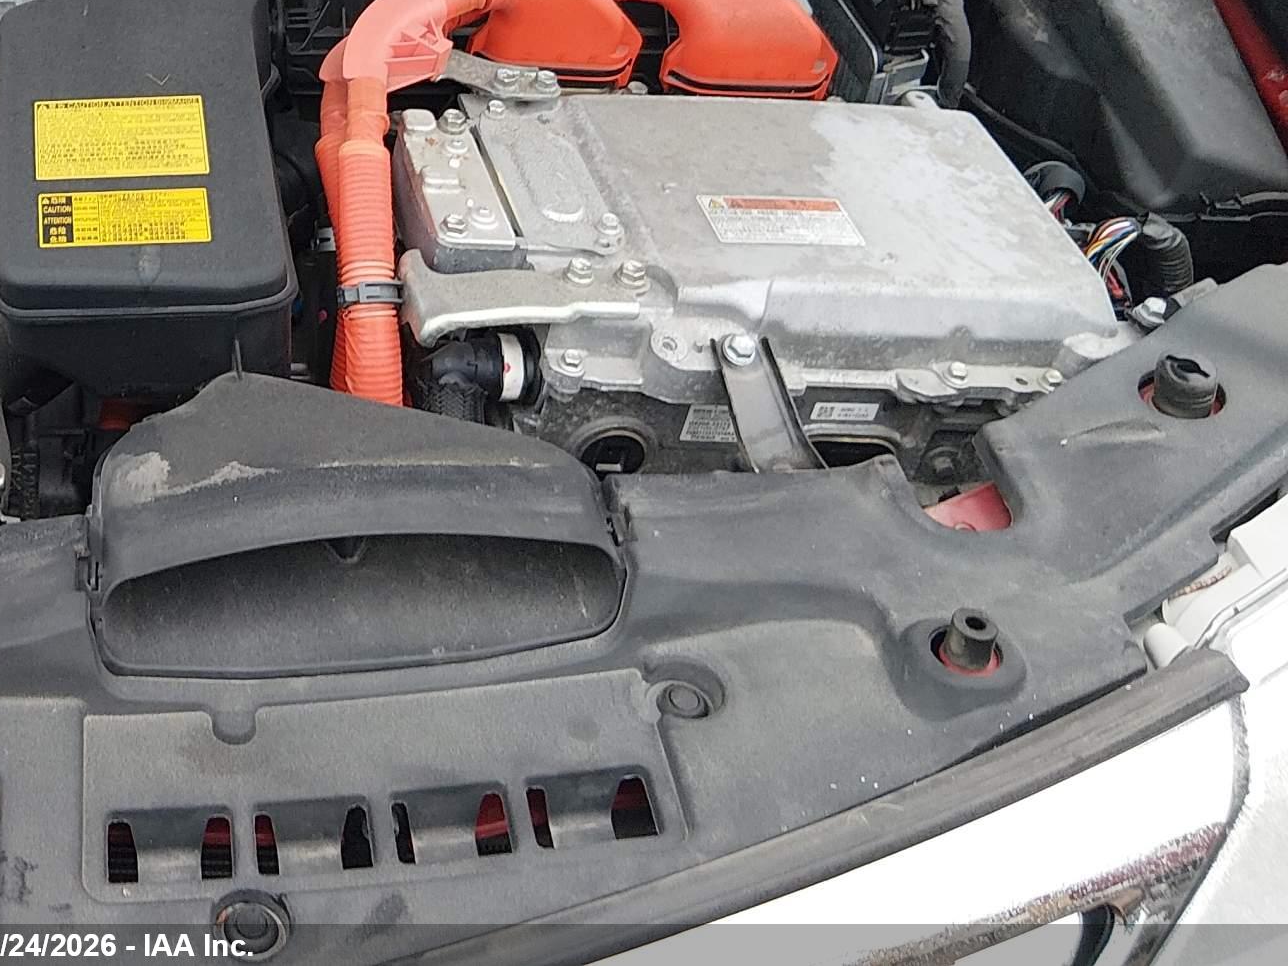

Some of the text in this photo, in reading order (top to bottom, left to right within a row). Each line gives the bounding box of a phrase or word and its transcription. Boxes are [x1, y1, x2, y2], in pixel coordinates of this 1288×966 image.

[68, 100, 105, 109] CAUTION
[43, 205, 72, 214] CAUTION
[43, 216, 72, 225] ATTENTION
